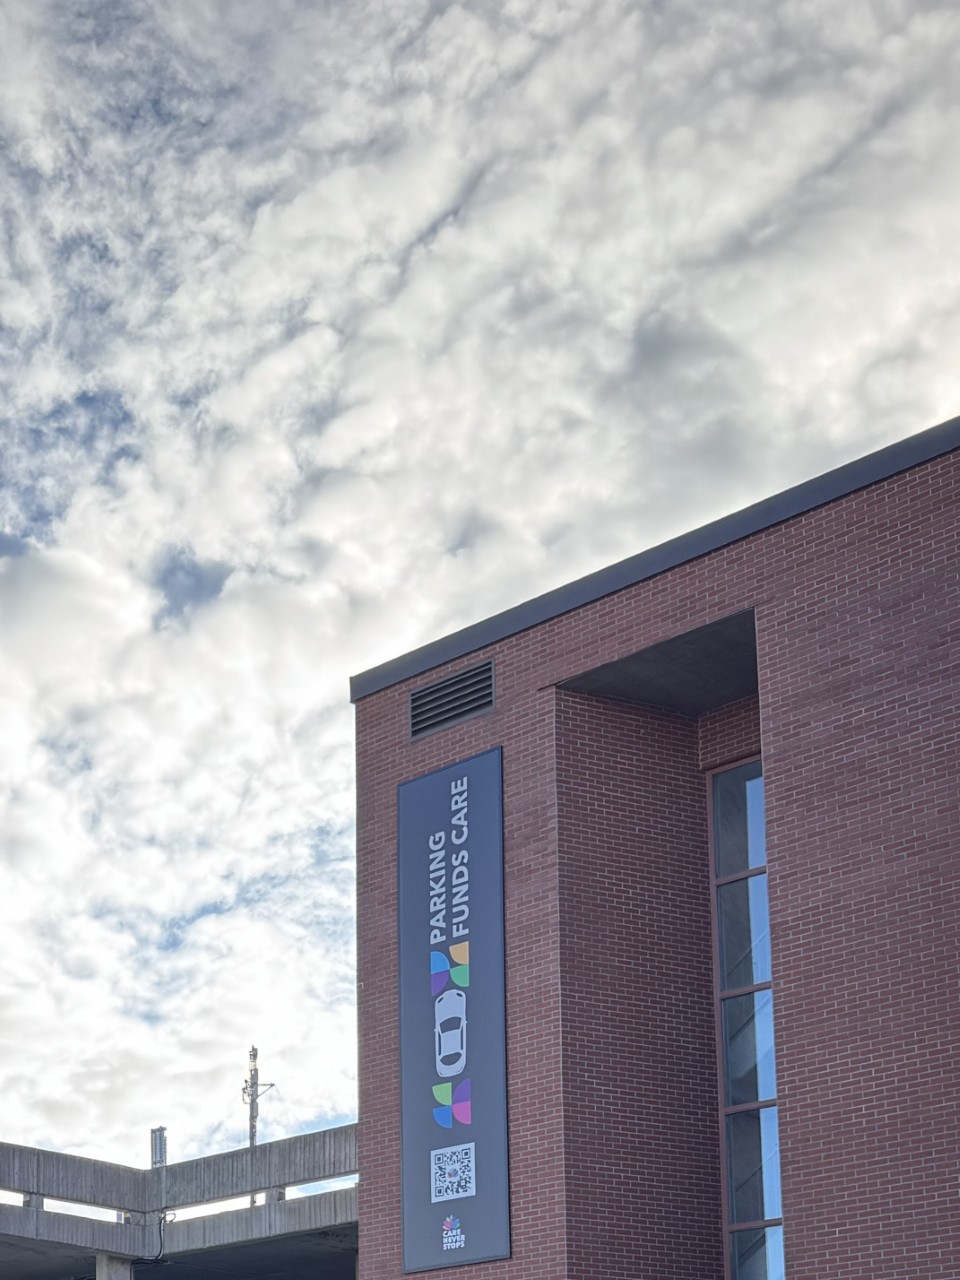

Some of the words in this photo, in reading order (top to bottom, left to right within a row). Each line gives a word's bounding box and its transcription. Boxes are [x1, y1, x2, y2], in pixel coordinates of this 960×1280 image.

[451, 776, 469, 845] CARE
[429, 831, 446, 945] PARKING
[451, 850, 469, 938] FUNDS
[442, 1229, 461, 1238] CARE
[442, 1234, 466, 1244] NEVER
[442, 1240, 465, 1250] STOPS
